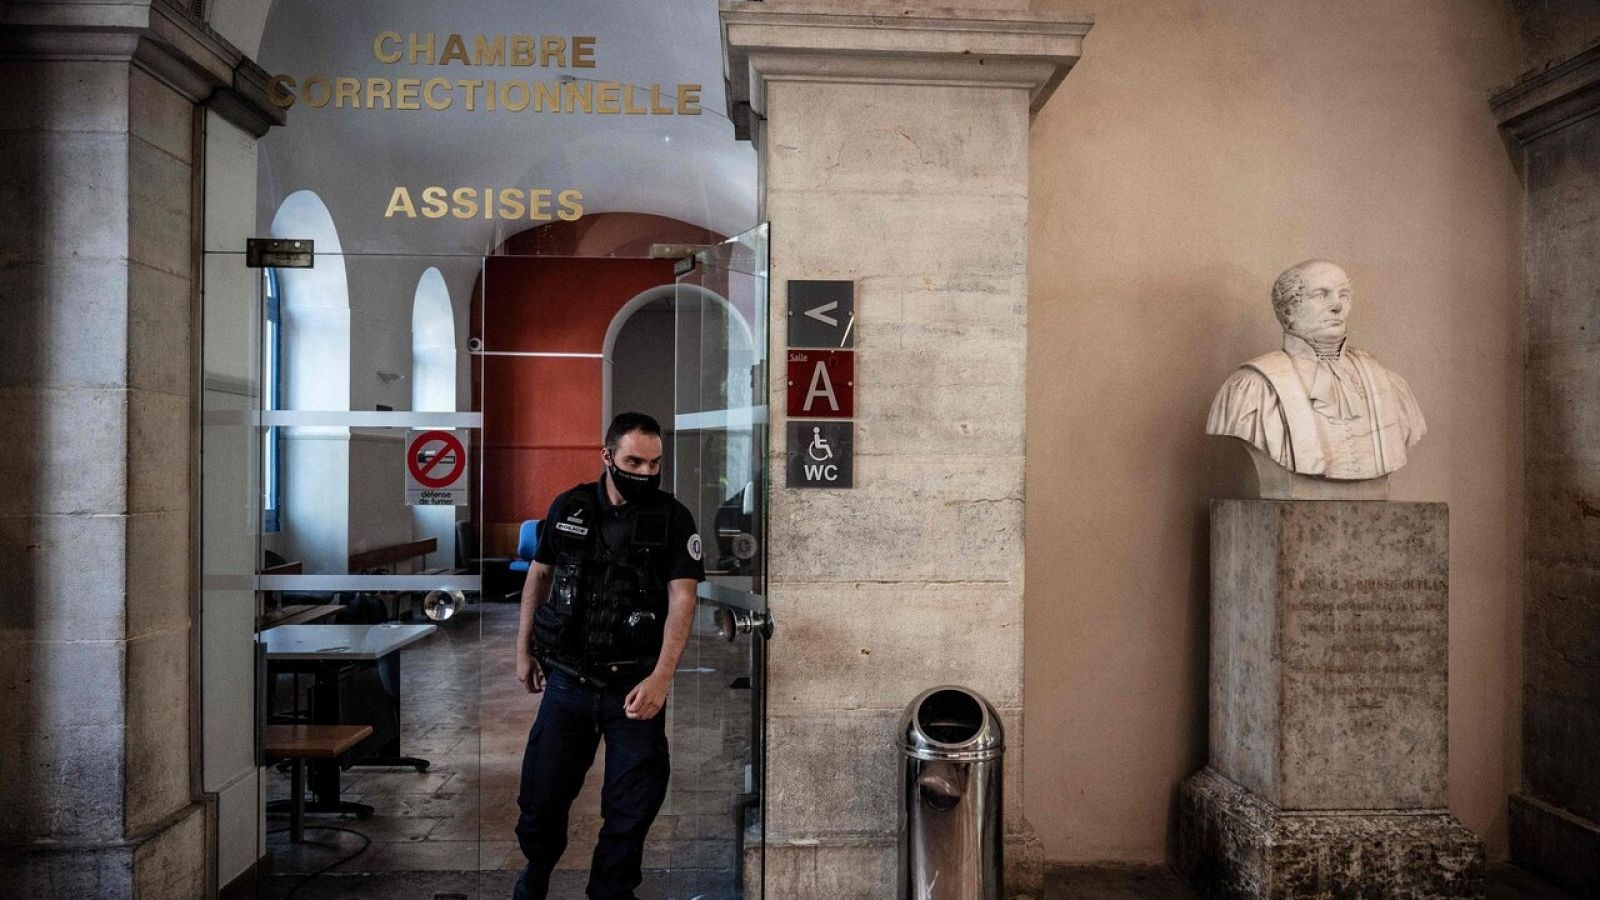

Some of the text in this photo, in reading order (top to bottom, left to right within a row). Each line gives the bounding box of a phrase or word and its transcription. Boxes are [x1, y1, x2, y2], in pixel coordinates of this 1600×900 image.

[373, 31, 597, 68] CHAMBRE
[267, 74, 703, 116] CORRECTIONNELLE
[384, 186, 584, 221] ASSISES
[790, 353, 808, 361] Salle
[803, 361, 839, 410] A
[803, 464, 838, 481] WC
[558, 524, 586, 534] POLICE
